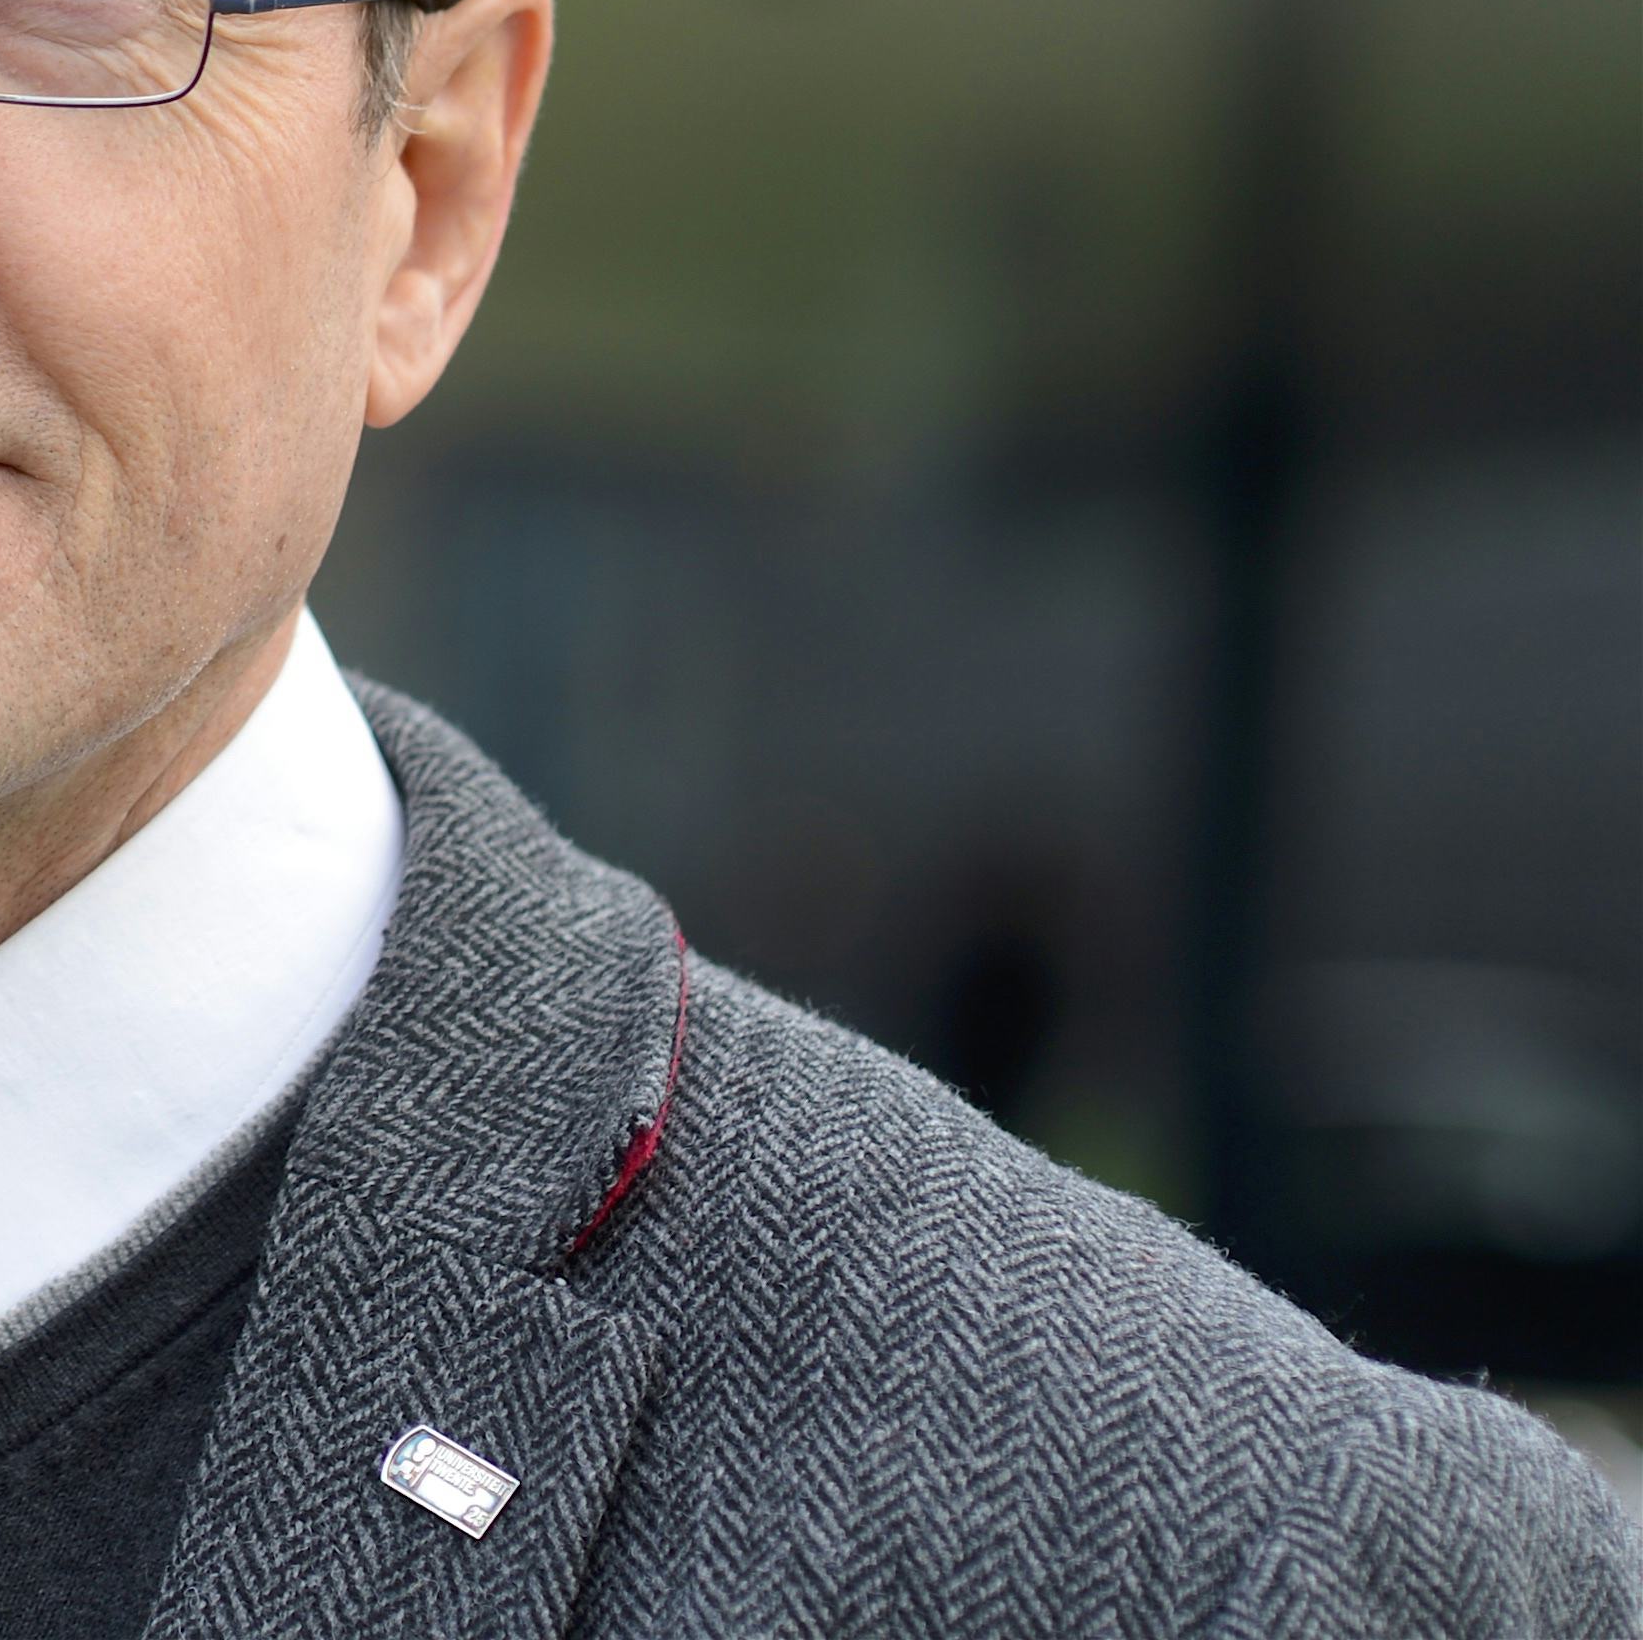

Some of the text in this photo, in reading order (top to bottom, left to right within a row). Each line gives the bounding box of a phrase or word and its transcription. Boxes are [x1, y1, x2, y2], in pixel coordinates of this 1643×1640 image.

[430, 1460, 476, 1496] TWENTE
[435, 1445, 511, 1497] UNIVERSITEIT
[462, 1505, 490, 1528] 25
